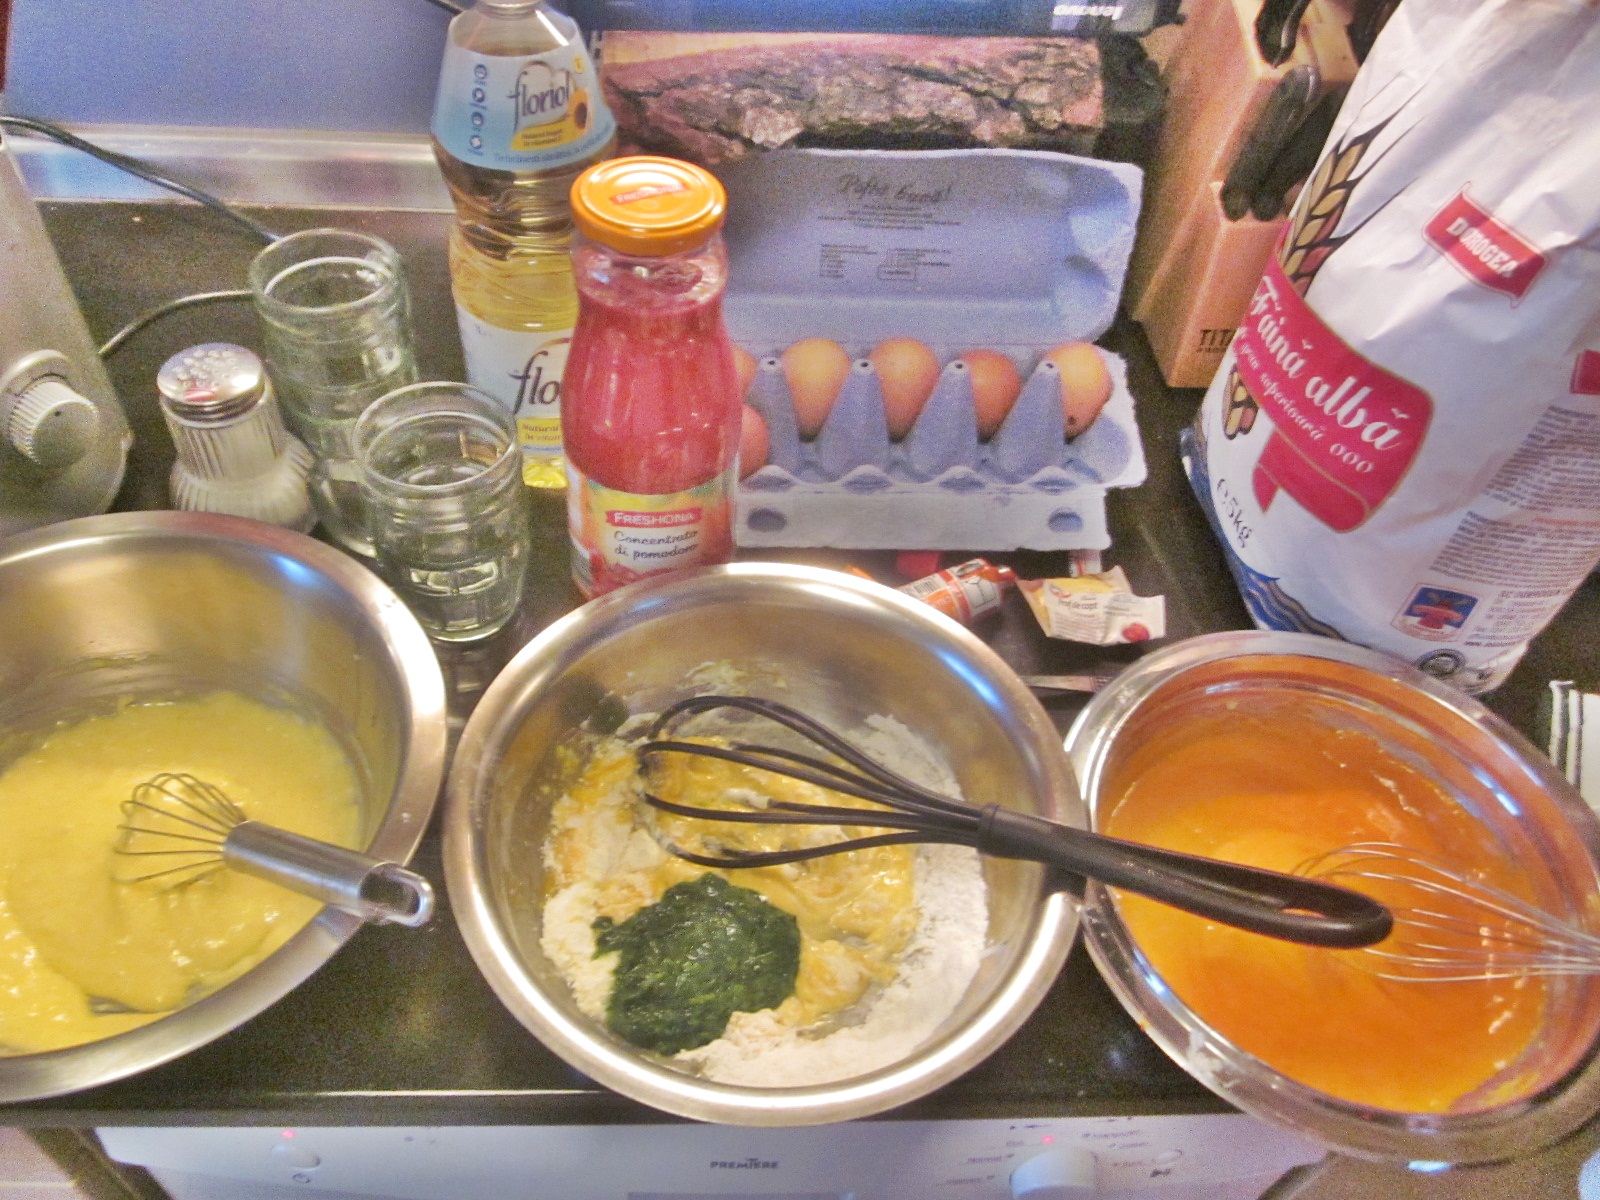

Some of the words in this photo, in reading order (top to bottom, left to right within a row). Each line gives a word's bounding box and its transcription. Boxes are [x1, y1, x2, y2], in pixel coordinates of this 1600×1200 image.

[506, 69, 571, 133] floriol
[1305, 376, 1410, 450] albă
[614, 512, 695, 525] FRESHONA
